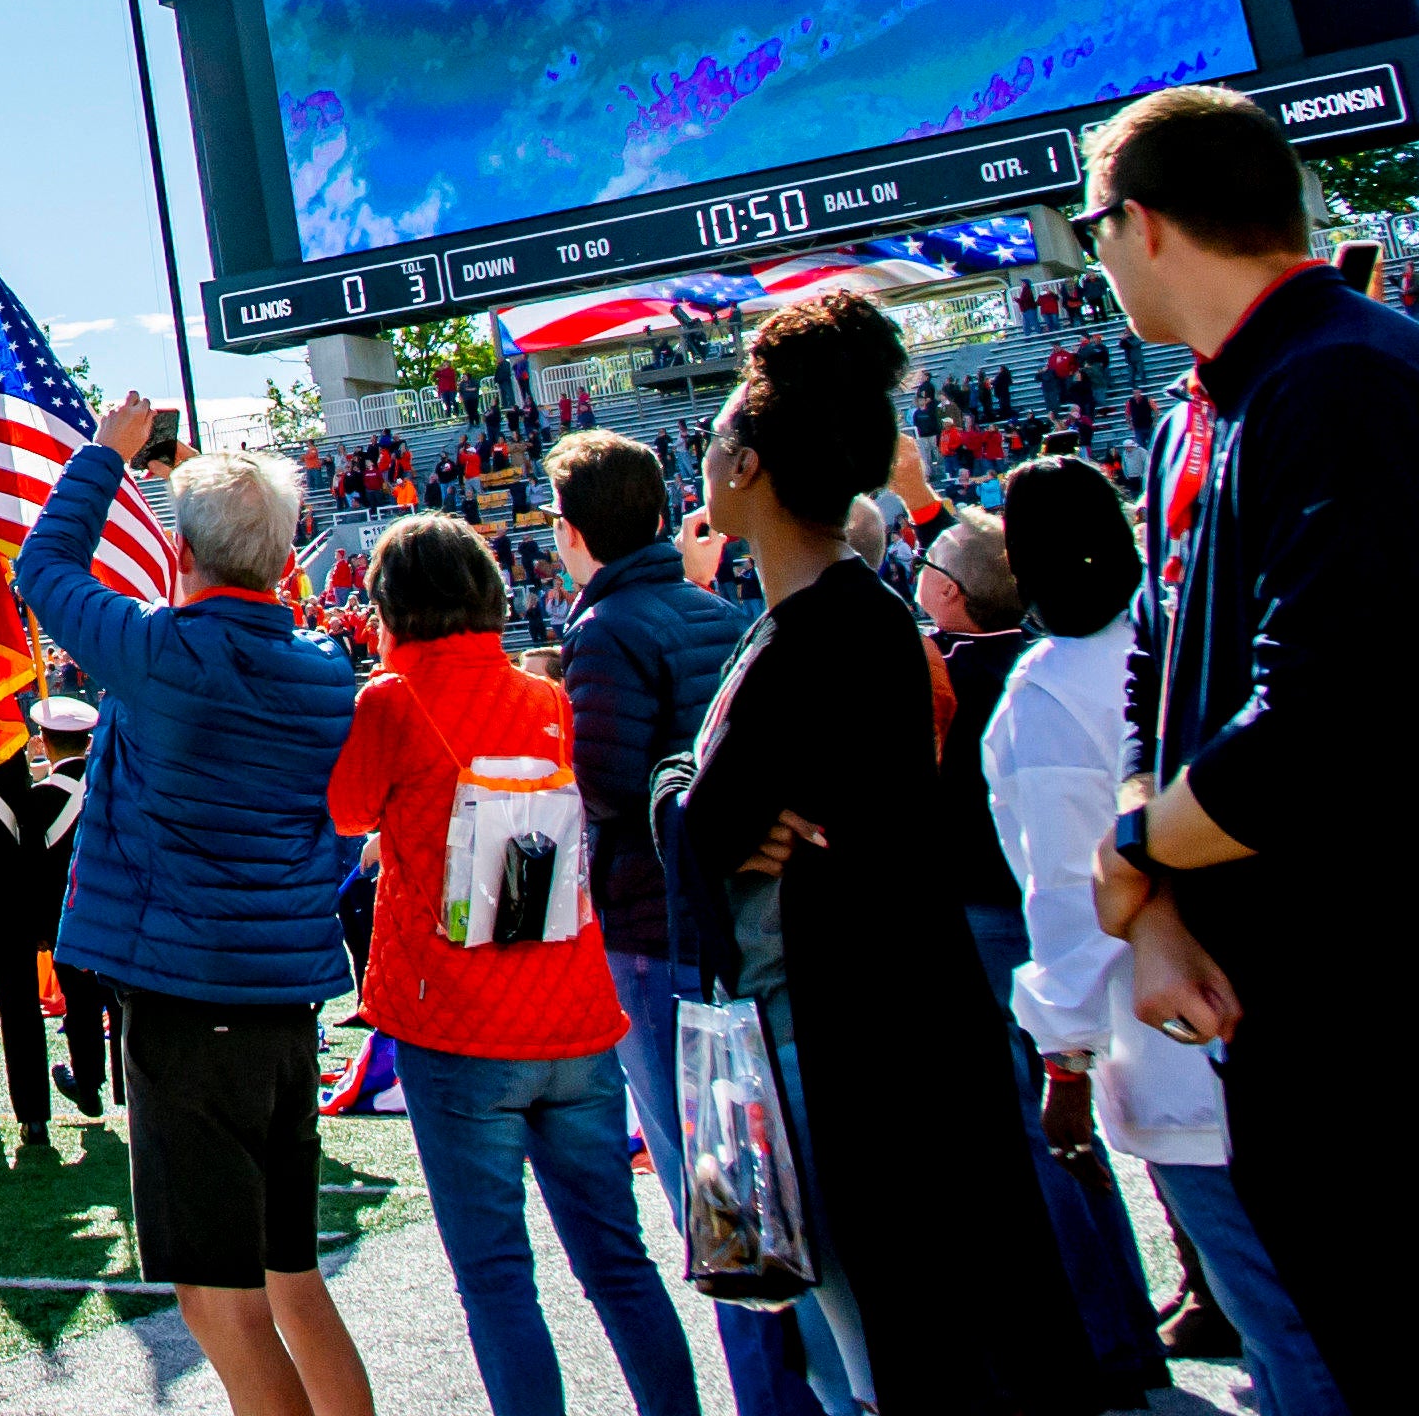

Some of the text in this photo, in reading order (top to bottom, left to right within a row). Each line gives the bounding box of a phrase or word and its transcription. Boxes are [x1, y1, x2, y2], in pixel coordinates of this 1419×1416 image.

[1280, 86, 1386, 125] WISCONSIN
[980, 146, 1059, 184] QTR. 1
[823, 181, 899, 214] BALL ON
[696, 189, 809, 246] 10:50
[556, 238, 610, 263] TO GO
[462, 256, 516, 282] DOWN
[342, 275, 366, 314] 0
[408, 275, 426, 303] 3
[240, 299, 293, 324] ILLINOIS
